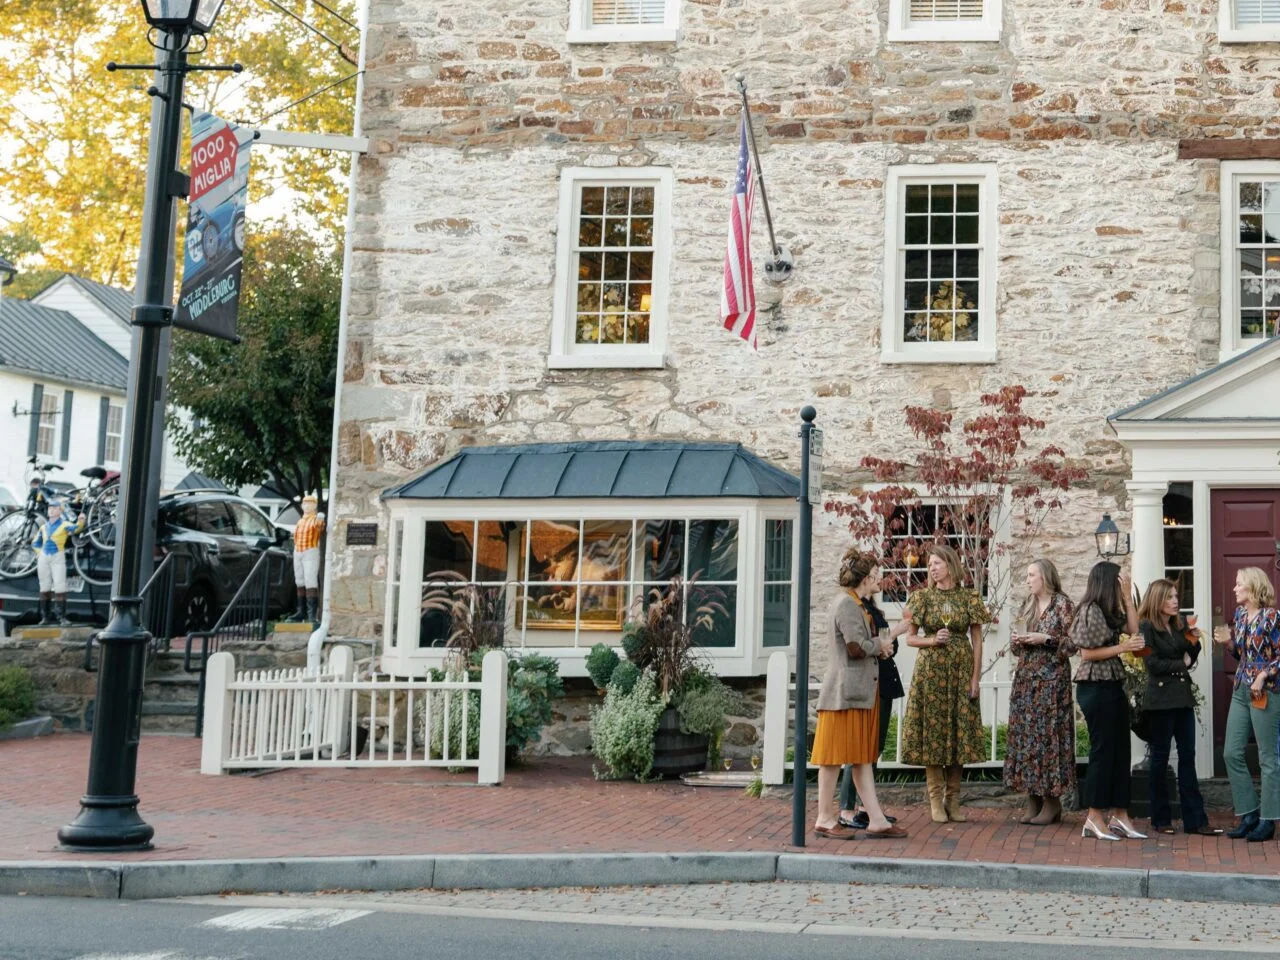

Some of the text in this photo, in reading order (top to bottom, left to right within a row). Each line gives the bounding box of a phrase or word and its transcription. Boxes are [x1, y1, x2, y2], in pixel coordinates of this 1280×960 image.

[193, 136, 225, 168] 1000
[194, 157, 231, 194] MIGLIA
[189, 274, 235, 320] MIDDLEBURG
